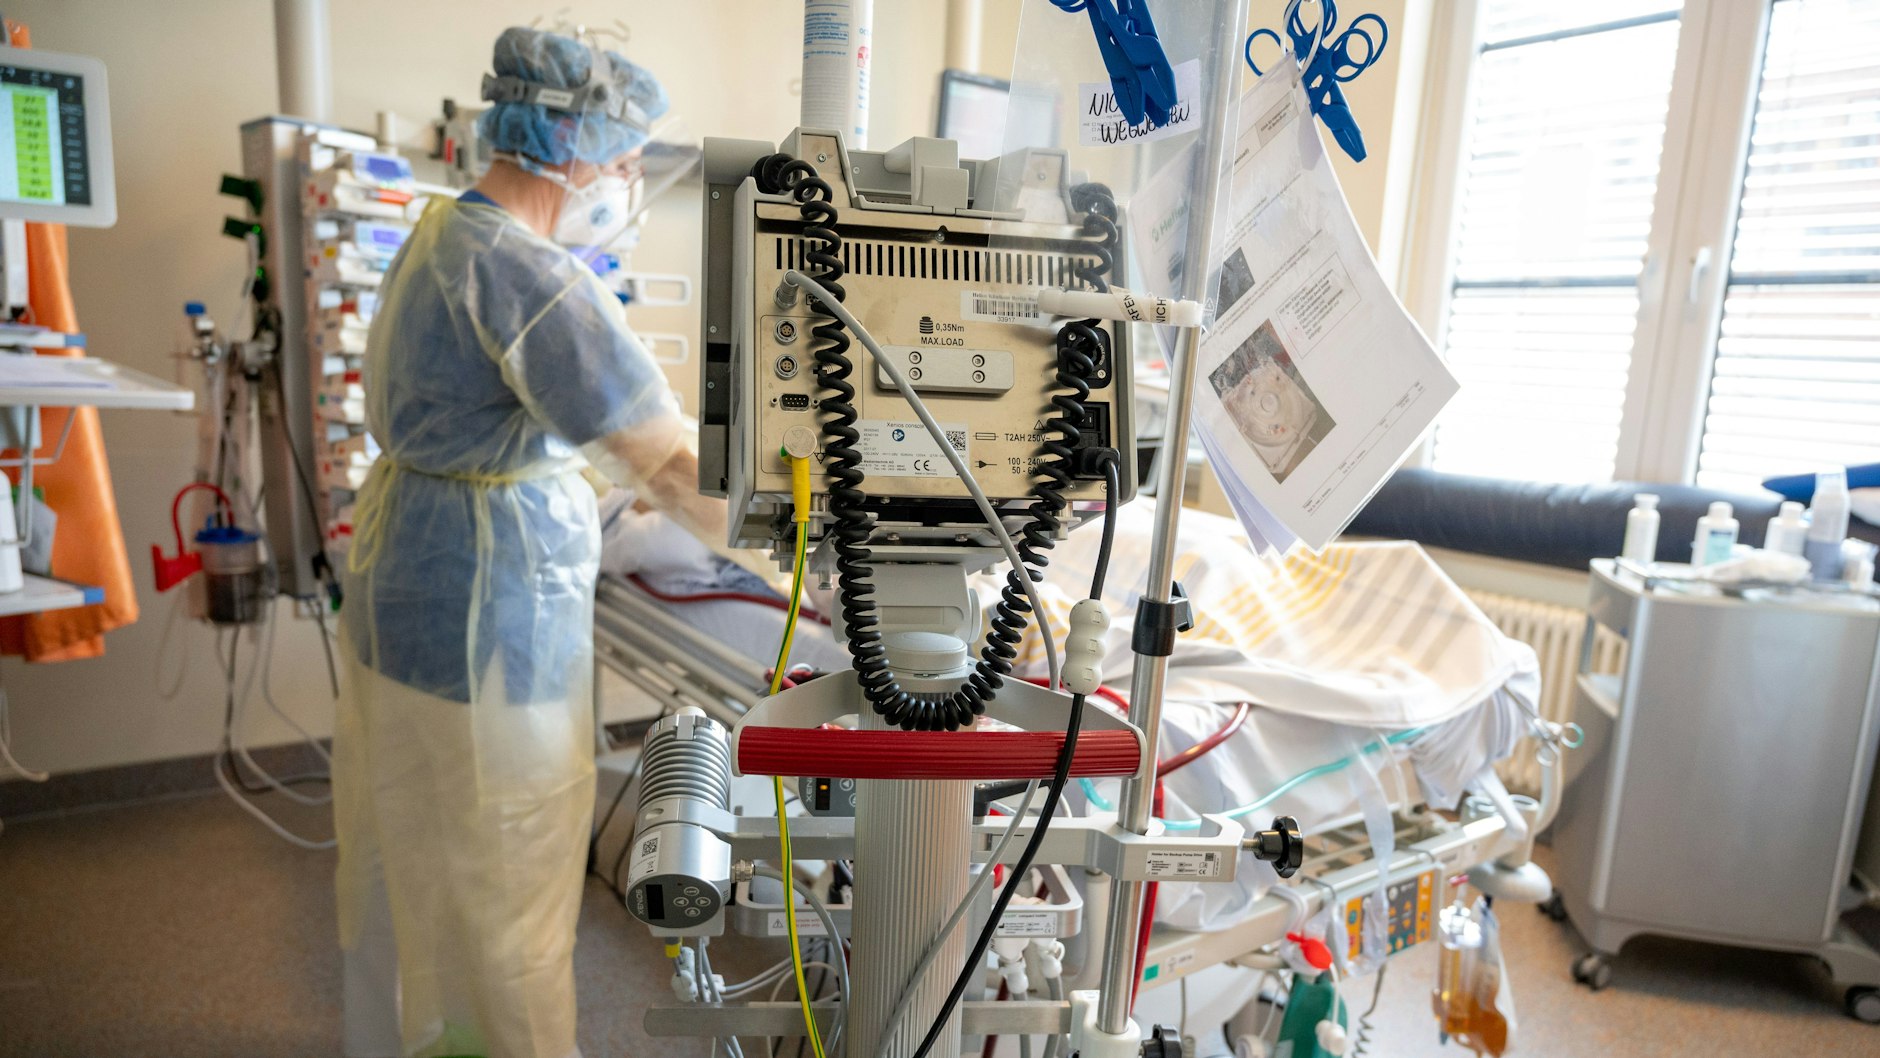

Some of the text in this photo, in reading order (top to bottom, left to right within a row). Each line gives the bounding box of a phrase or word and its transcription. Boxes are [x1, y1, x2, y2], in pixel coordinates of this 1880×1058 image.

[1088, 92, 1119, 117] NIC
[935, 322, 965, 332] 0,35Nm
[920, 336, 964, 346] MAX.LOAD
[1004, 433, 1026, 442] T2AH
[1007, 457, 1021, 465] 100
[1027, 457, 1049, 466] 240V
